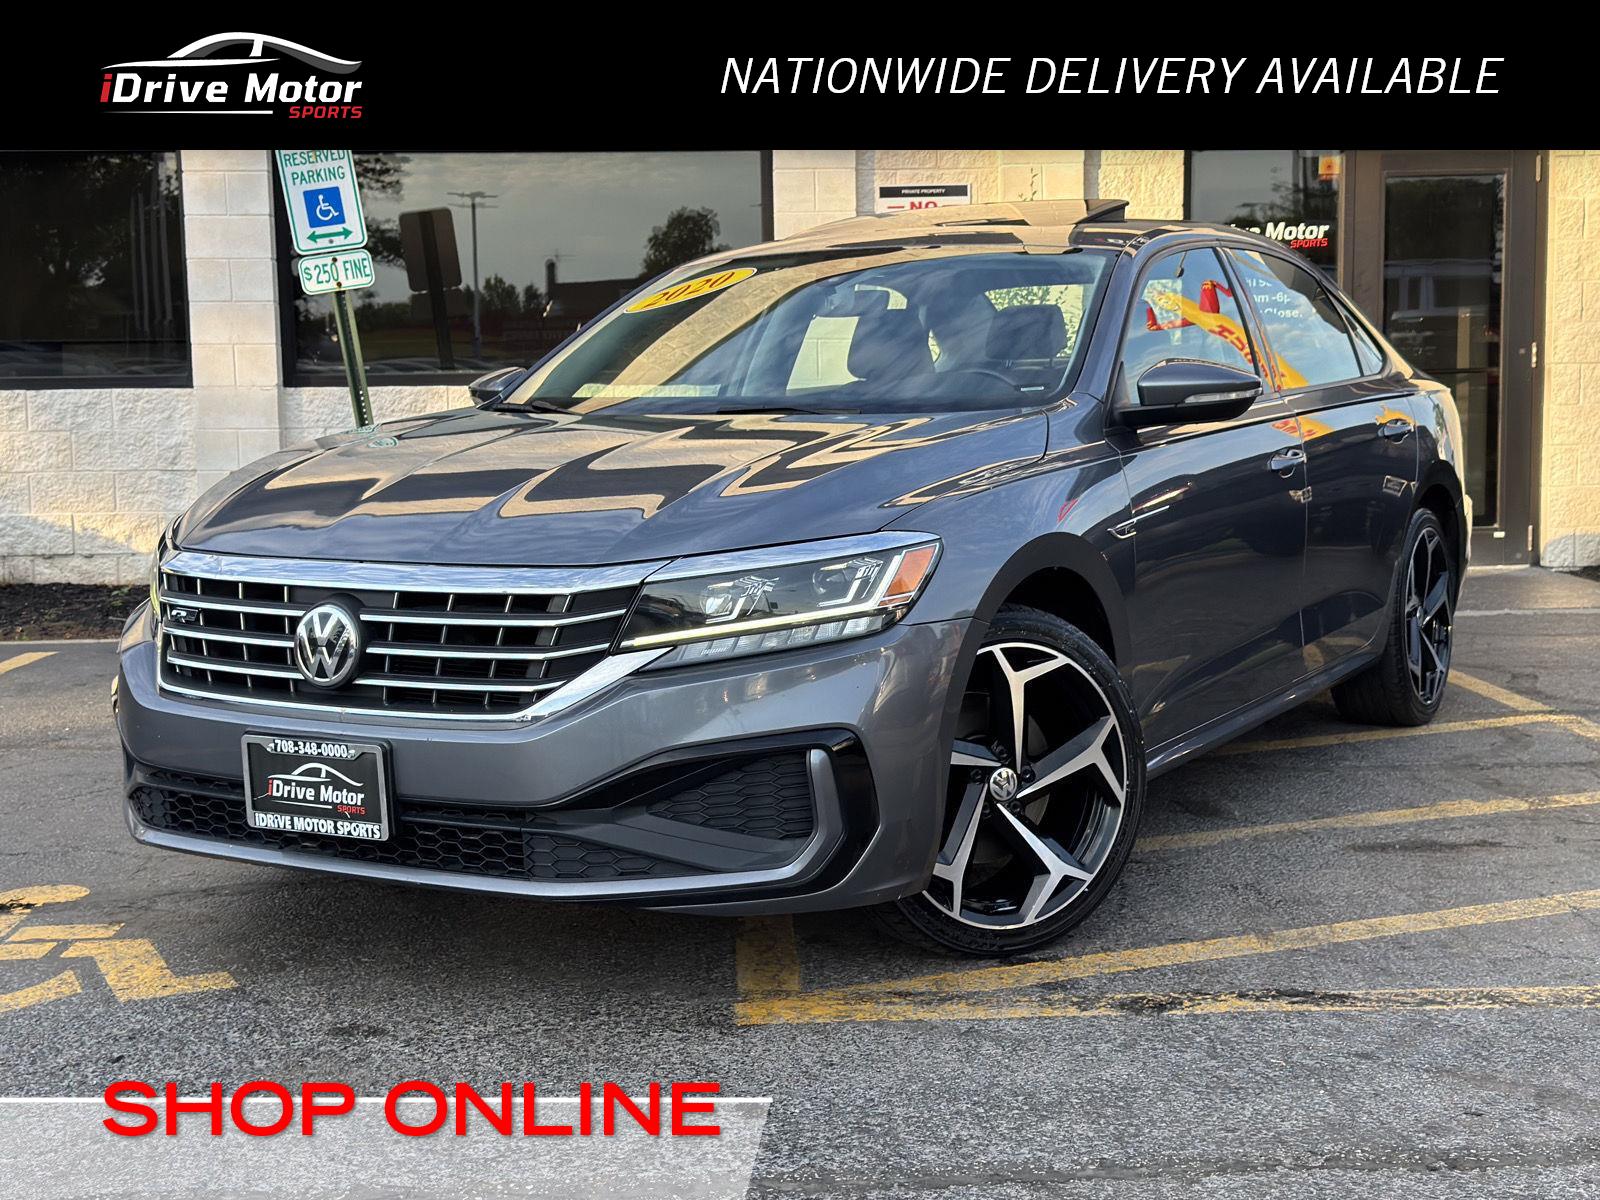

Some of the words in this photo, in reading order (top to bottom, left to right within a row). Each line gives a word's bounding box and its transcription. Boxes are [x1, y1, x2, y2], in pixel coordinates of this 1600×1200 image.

[283, 150, 346, 167] RESERVED
[291, 166, 345, 186] PARKING
[1264, 221, 1330, 241] Motor
[1289, 237, 1329, 249] SPORTS
[303, 262, 340, 285] $250
[342, 257, 371, 281] FINE
[642, 271, 736, 309] 2020
[274, 739, 348, 758] 708-348-0000
[267, 779, 315, 801] iDrive
[319, 785, 365, 806] Motor
[337, 804, 367, 815] SPORTS
[293, 816, 335, 835] MOTOR
[336, 822, 381, 840] SPORTS
